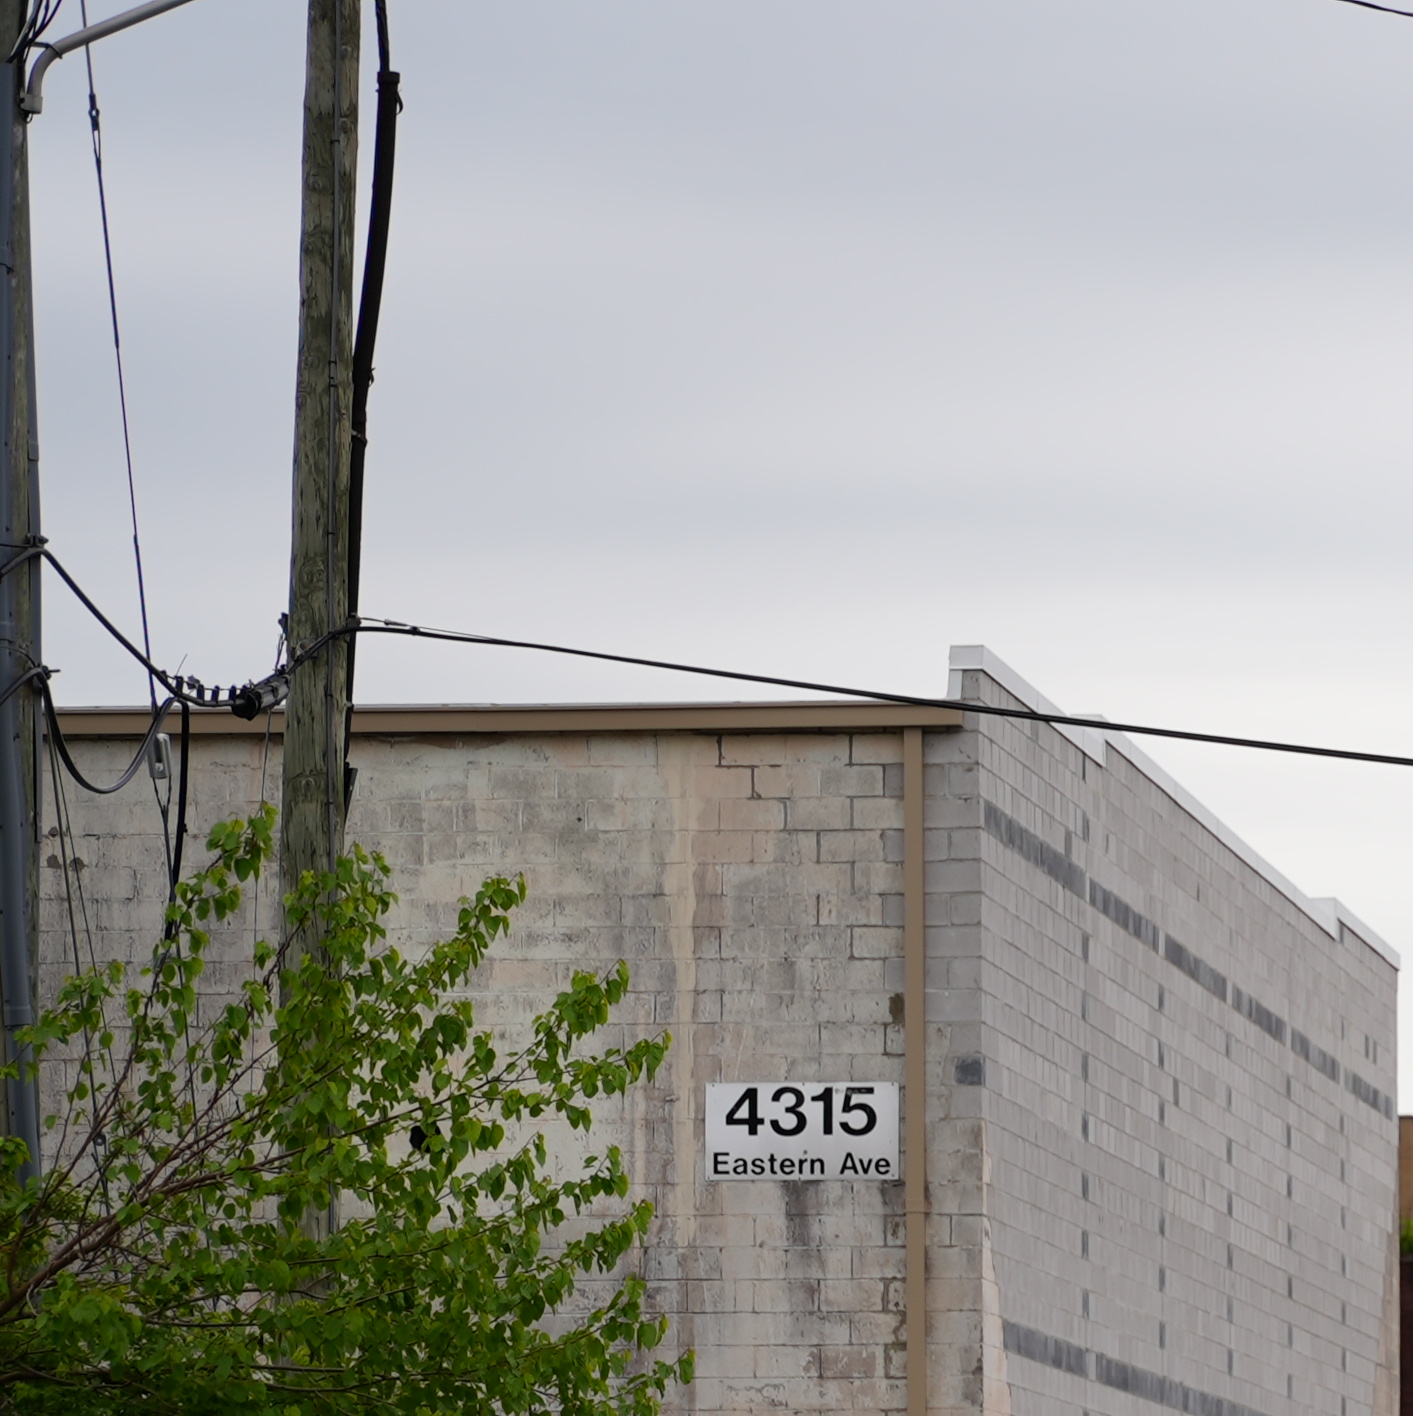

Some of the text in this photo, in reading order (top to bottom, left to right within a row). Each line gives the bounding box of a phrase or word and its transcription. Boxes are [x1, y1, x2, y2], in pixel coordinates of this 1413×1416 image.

[725, 1086, 878, 1137] 4315
[712, 1151, 892, 1176] Eastern Ave
